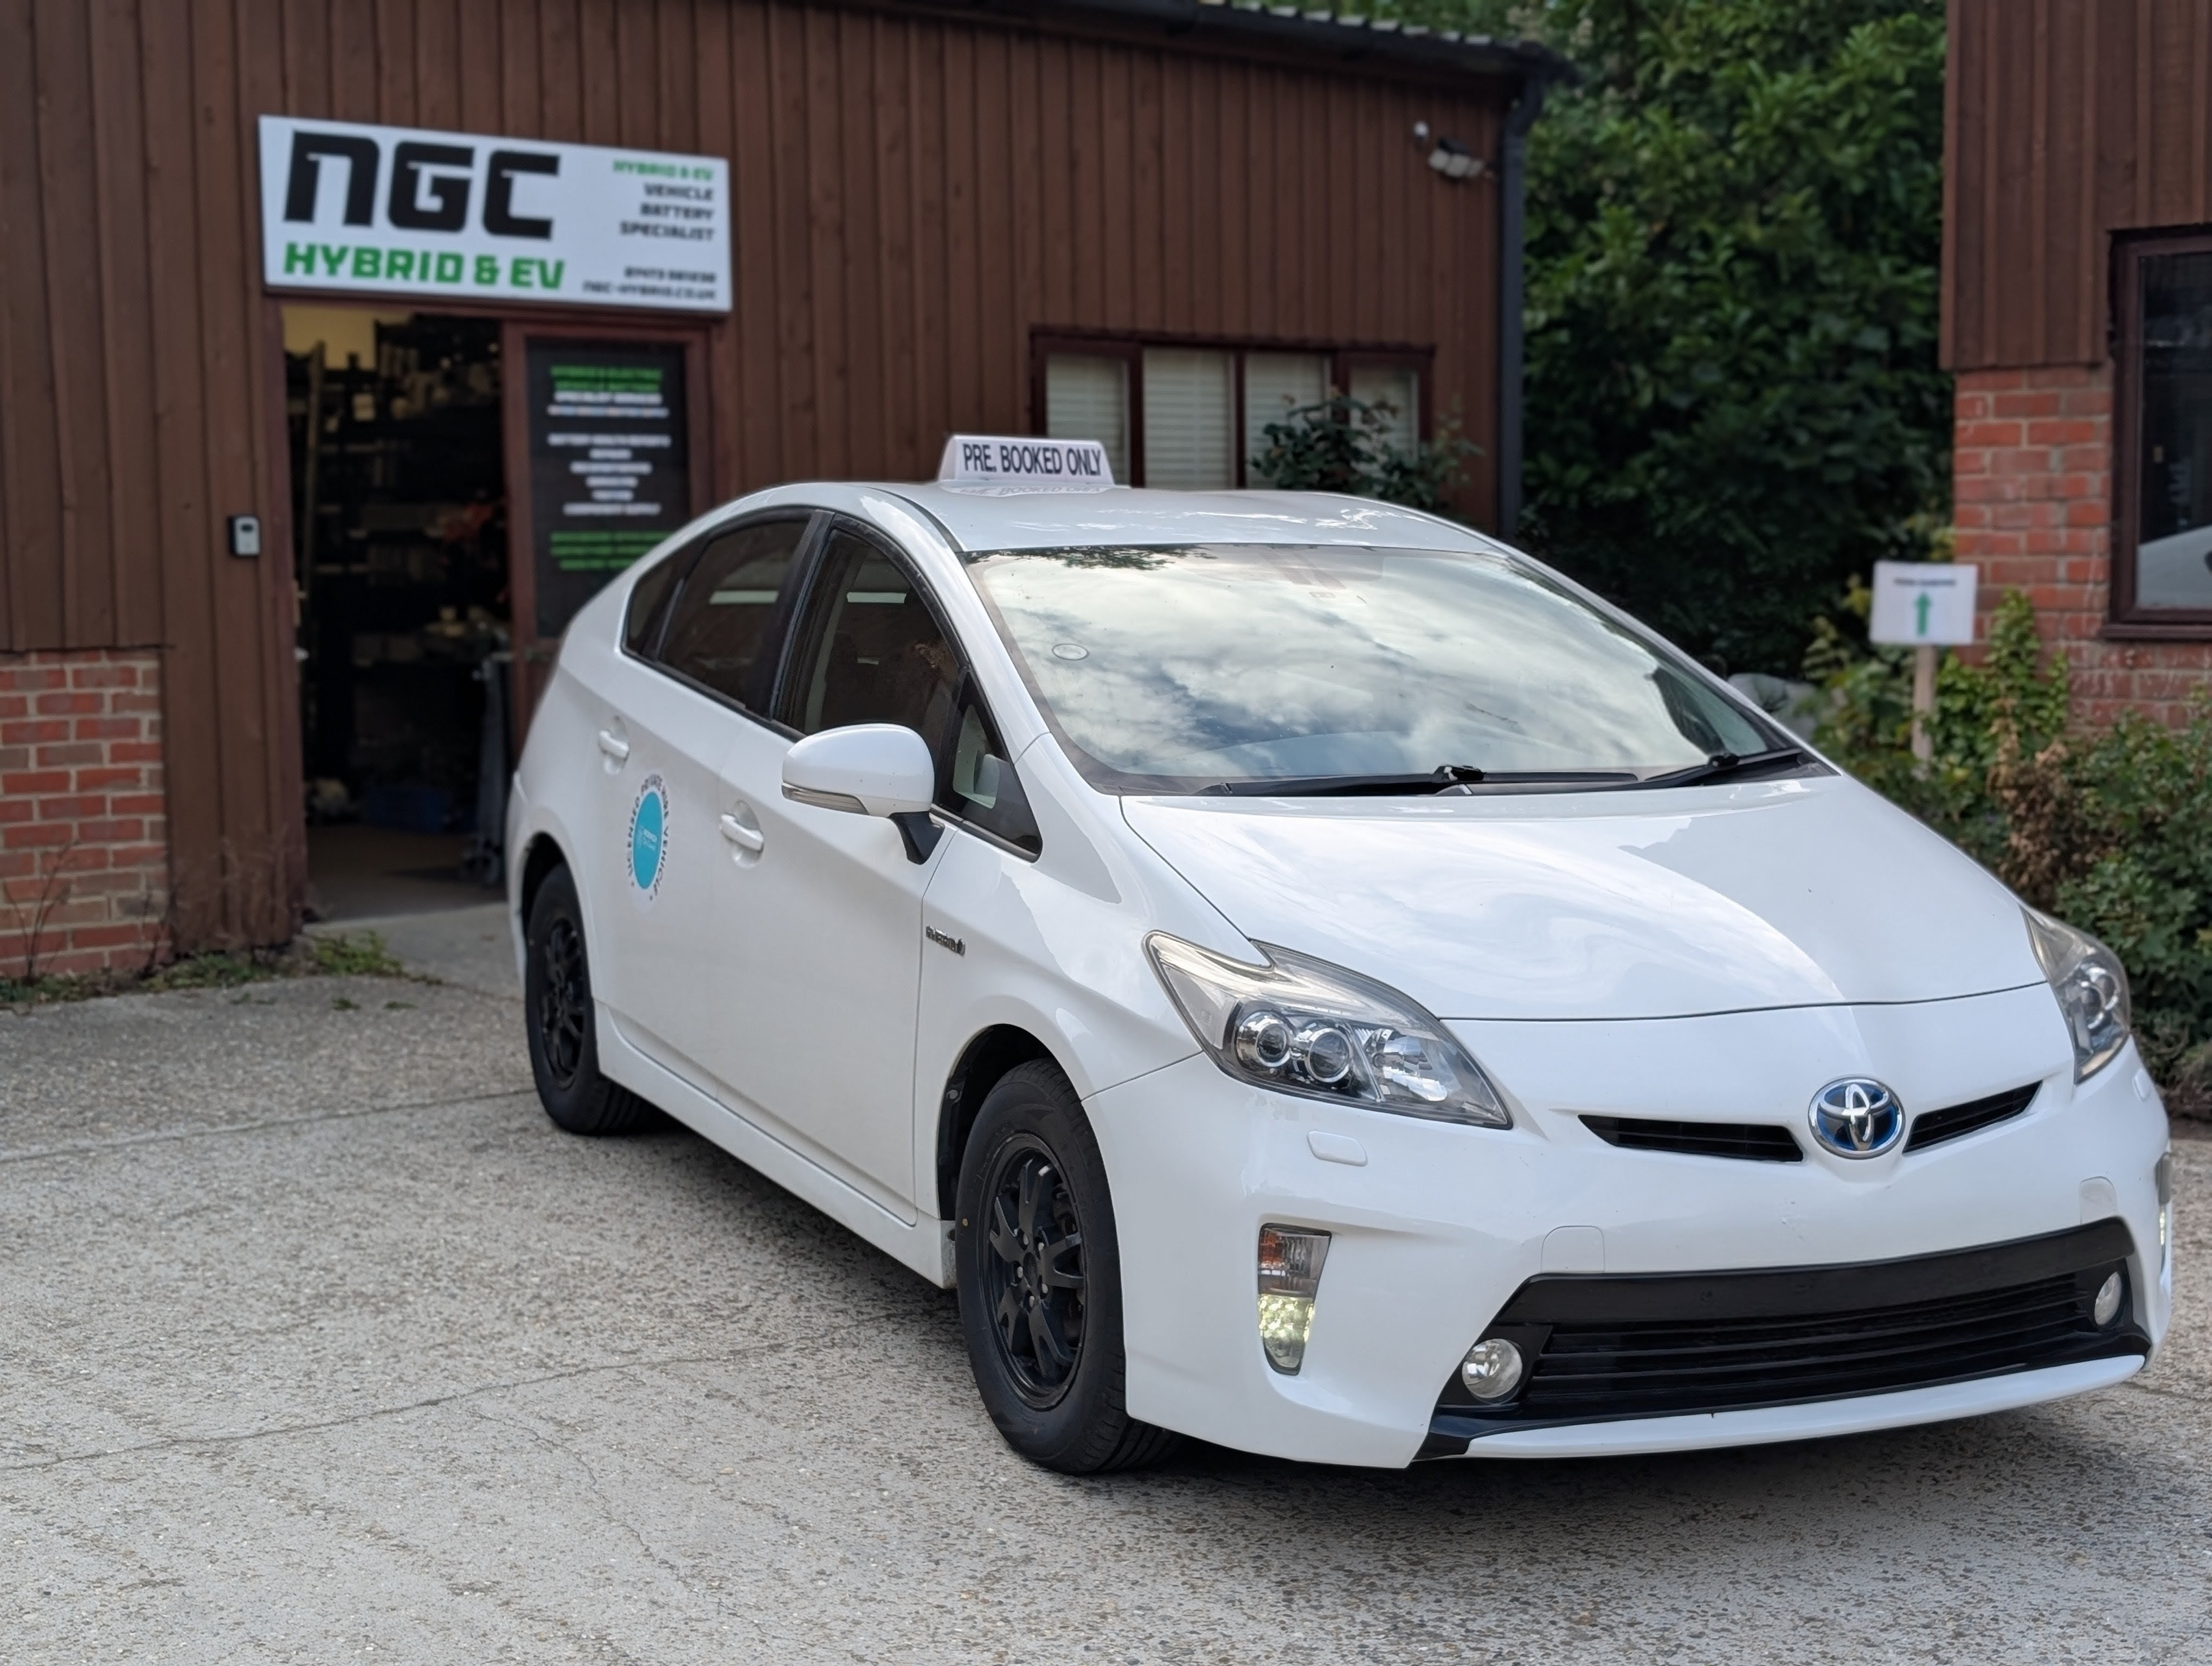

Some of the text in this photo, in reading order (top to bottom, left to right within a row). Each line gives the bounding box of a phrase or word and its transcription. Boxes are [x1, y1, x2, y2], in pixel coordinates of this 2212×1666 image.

[612, 159, 677, 178] HYBRID
[692, 167, 714, 182] EV
[644, 183, 713, 201] VEHICLE
[640, 202, 714, 220] BATTERY
[620, 221, 714, 240] SPECIALIST
[283, 242, 565, 290] HYBRID & EV
[963, 443, 1101, 476] PRE. BOOKED ONLY
